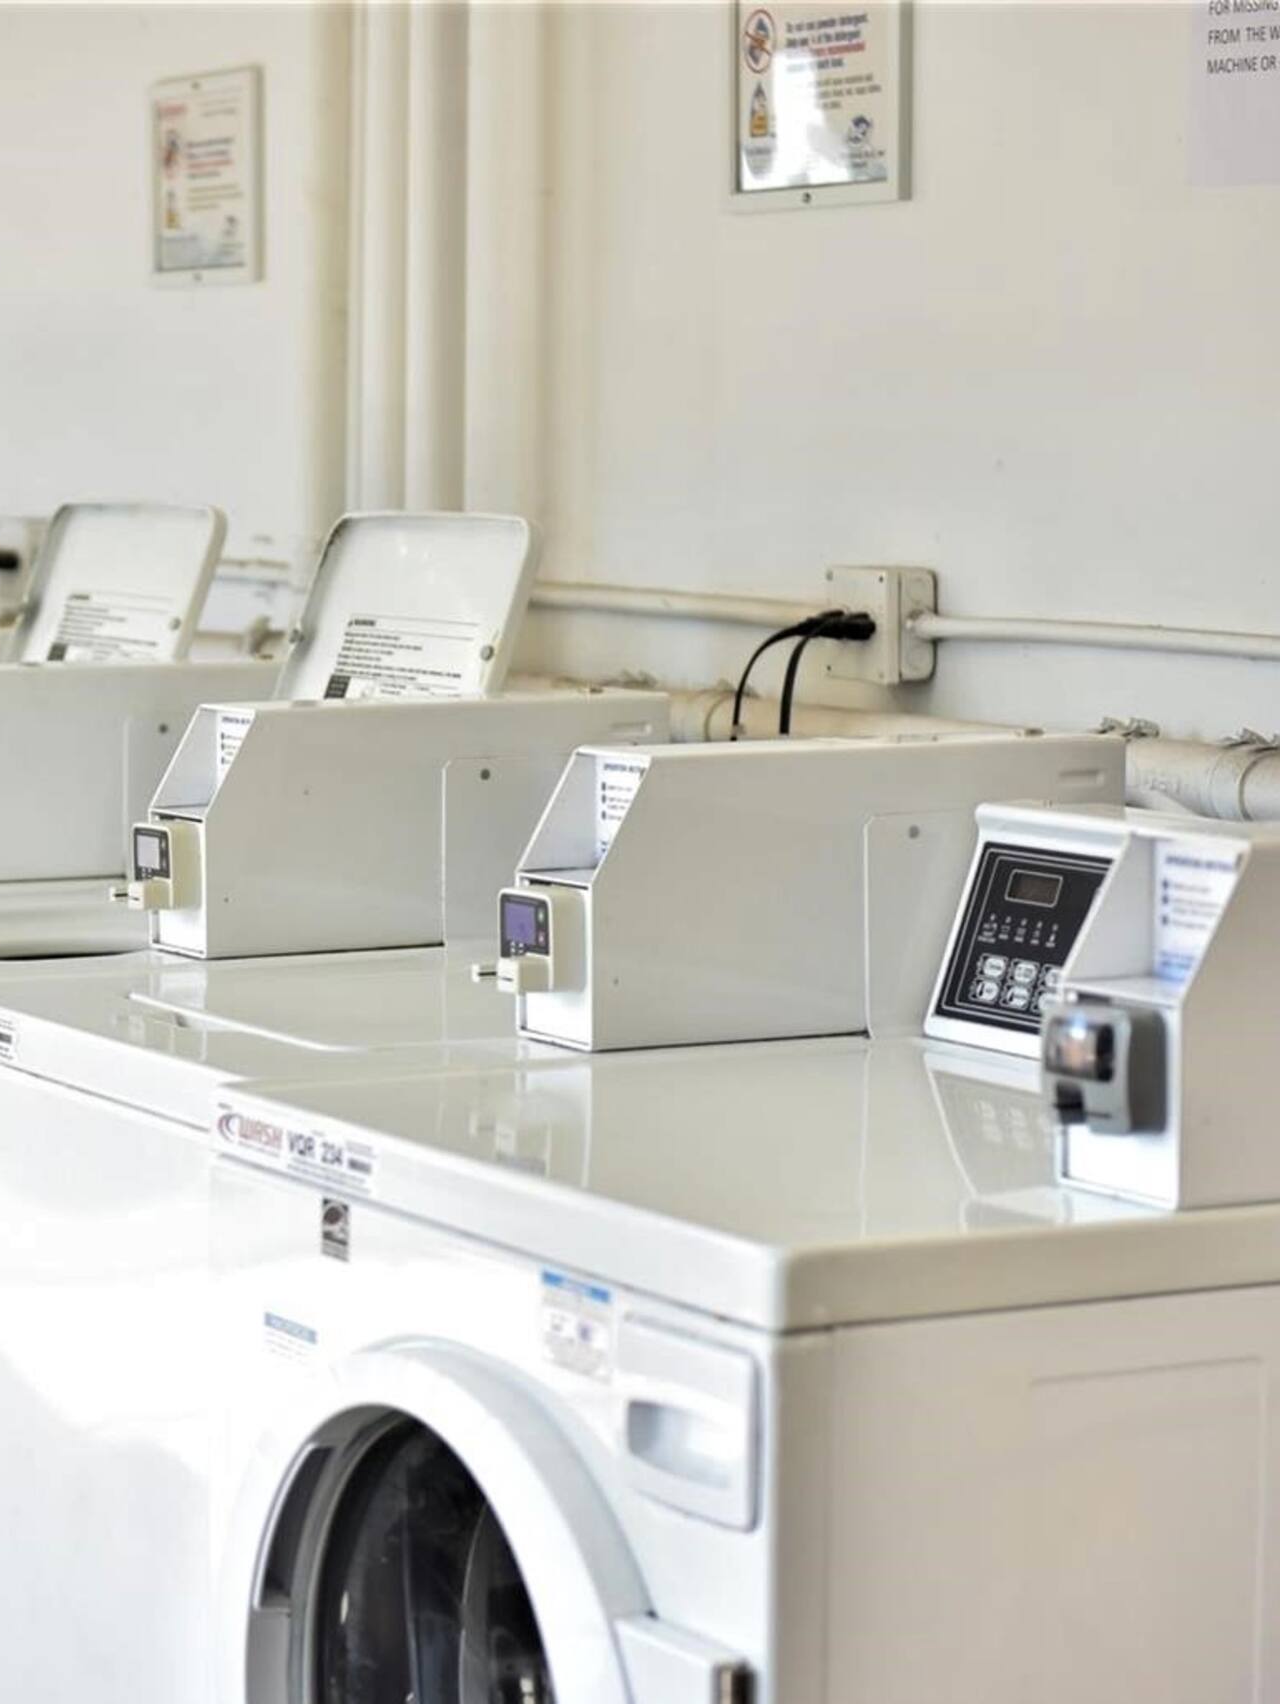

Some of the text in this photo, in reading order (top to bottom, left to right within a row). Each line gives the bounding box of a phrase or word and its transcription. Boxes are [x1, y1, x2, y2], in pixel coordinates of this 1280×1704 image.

[1209, 0, 1279, 15] FOR MISSING
[1208, 28, 1241, 46] FROM
[1246, 26, 1267, 42] THE
[1207, 55, 1277, 74] MACHINE OR
[238, 1115, 284, 1151] WASH
[287, 1129, 317, 1159] VQR
